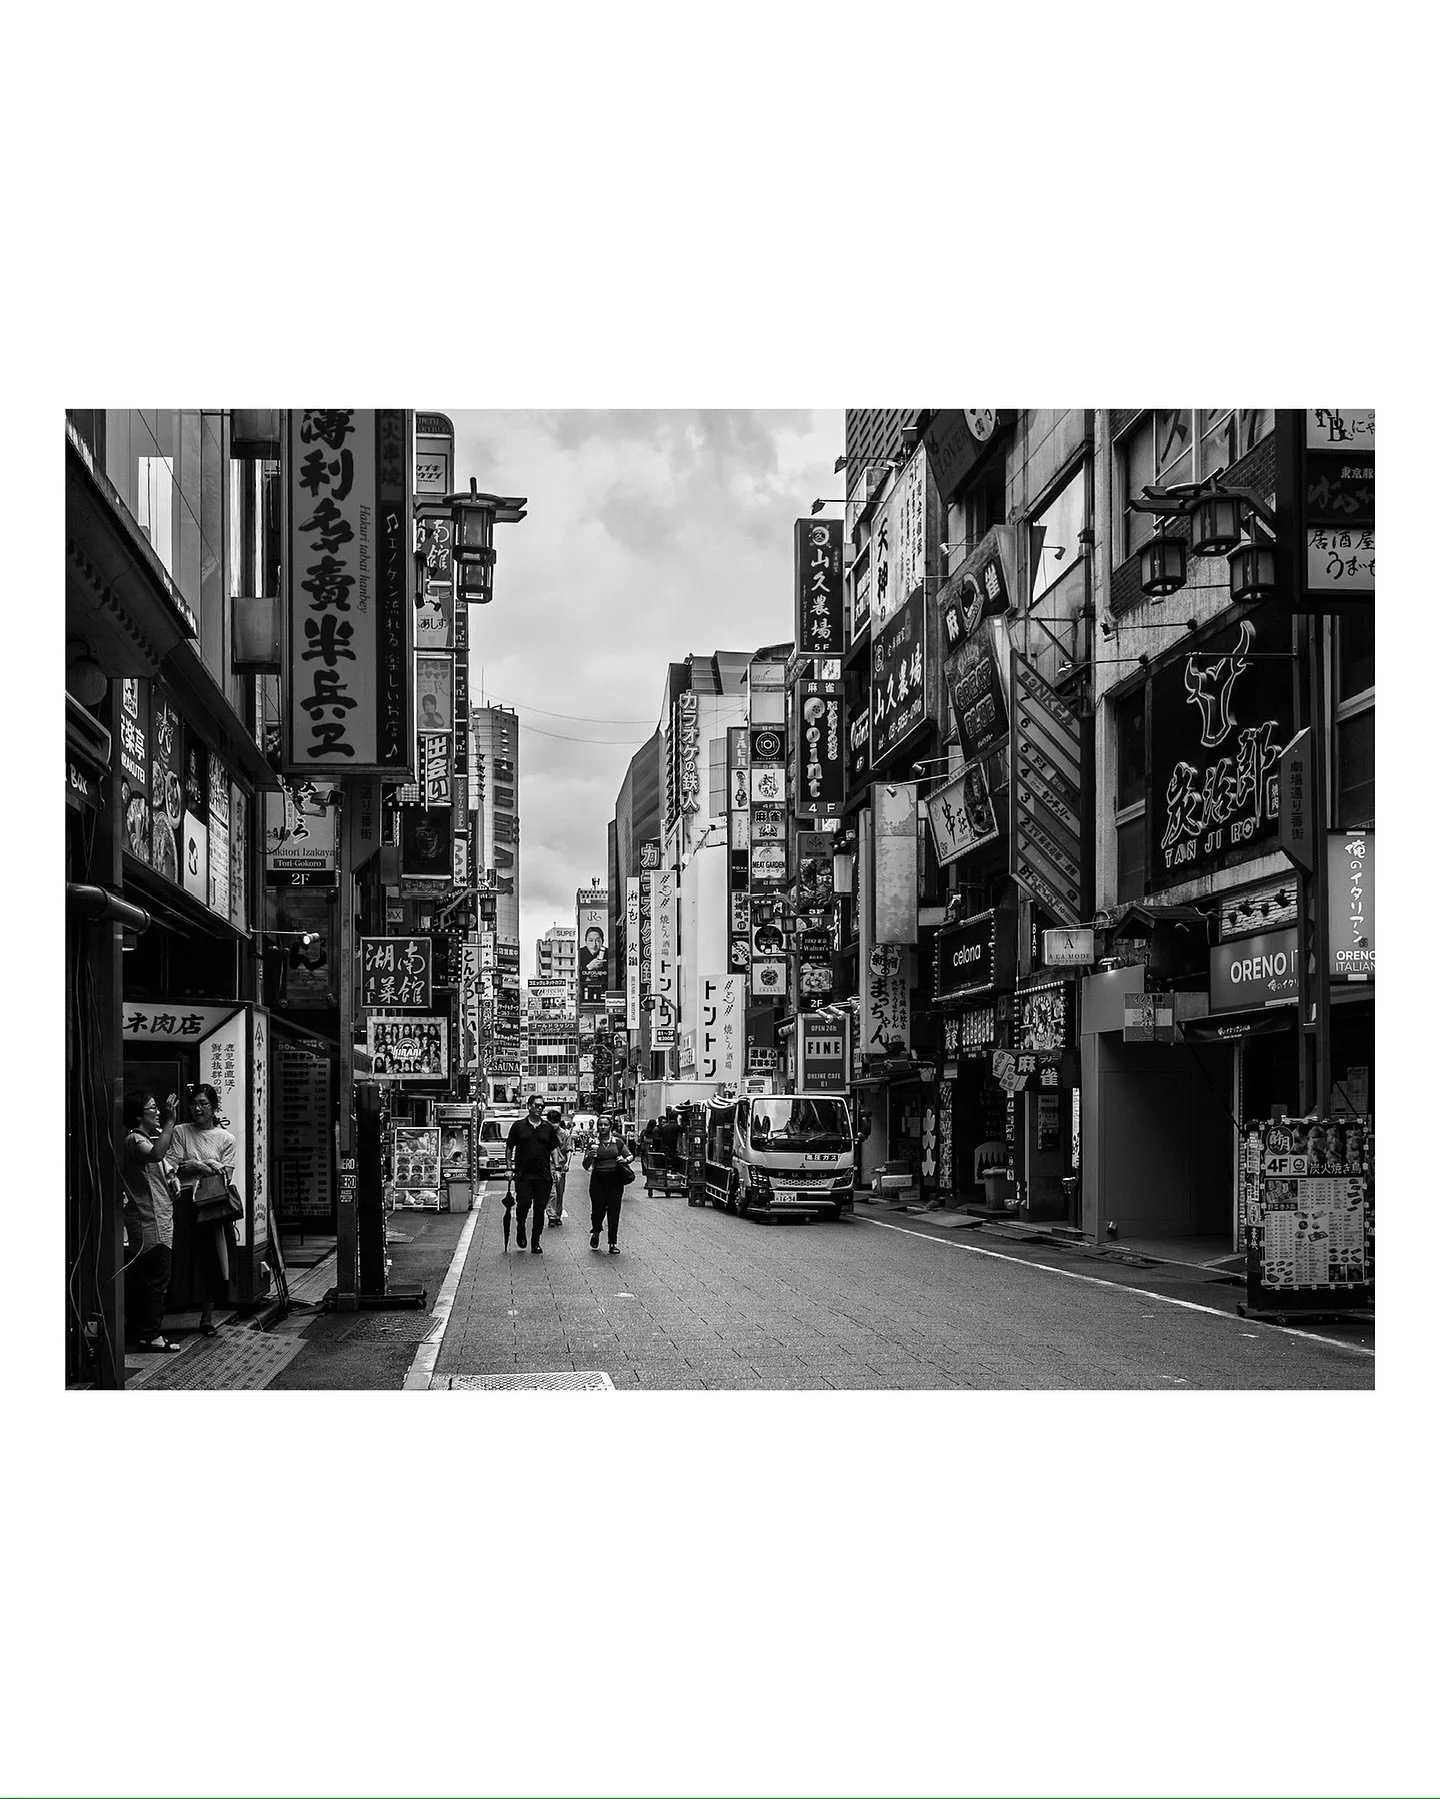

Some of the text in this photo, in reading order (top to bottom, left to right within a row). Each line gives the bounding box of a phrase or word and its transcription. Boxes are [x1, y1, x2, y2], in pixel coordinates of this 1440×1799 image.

[358, 504, 371, 614] Hakuri tabai hanbey
[809, 548, 833, 642] 山久農場
[807, 682, 839, 693] 麻雀
[1019, 692, 1031, 702] 7
[1020, 717, 1031, 728] 6
[682, 691, 699, 813] カラオケの鉄人
[803, 697, 826, 798] Point
[1020, 742, 1032, 754] 5
[1020, 768, 1071, 820] 4 センチュリー
[1020, 792, 1031, 803] 3
[755, 811, 782, 823] 麻雀
[1020, 817, 1031, 828] 2
[1164, 818, 1254, 868] TAN JI RO
[752, 861, 765, 869] MEAT
[766, 861, 785, 869] GARDEN
[291, 873, 310, 885] 2F
[1064, 938, 1074, 949] A
[952, 944, 981, 967] celona
[1230, 951, 1287, 984] ORENO
[810, 999, 823, 1008] 2F
[870, 977, 891, 1046] まっちゃん
[122, 1012, 205, 1035] ネ肉店
[703, 980, 717, 1078] トントン
[807, 1041, 841, 1055] FINE
[493, 1061, 520, 1072] SAUNA
[1267, 1158, 1289, 1173] 4F
[1309, 1161, 1362, 1175] 炭火焼き鳥
